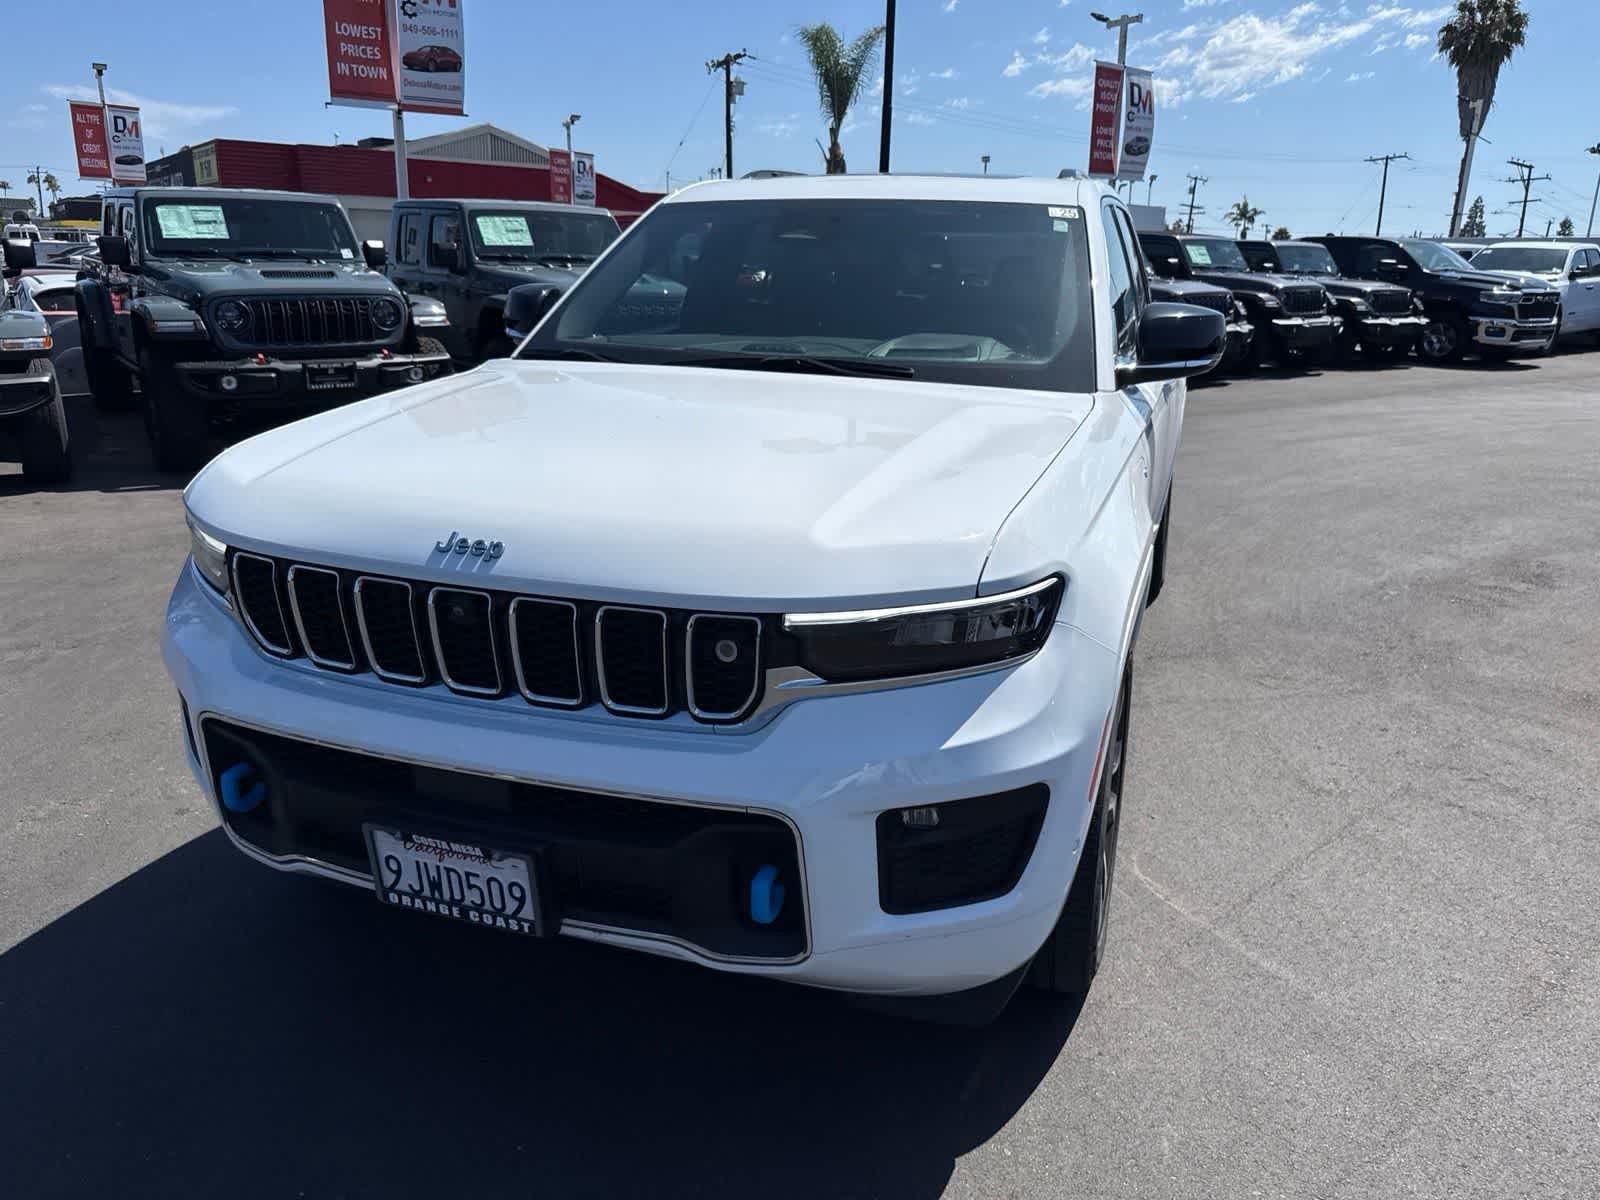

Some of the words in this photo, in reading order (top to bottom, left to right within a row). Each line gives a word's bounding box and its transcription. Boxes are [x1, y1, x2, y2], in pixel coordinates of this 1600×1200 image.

[335, 21, 382, 41] LOWEST
[340, 42, 382, 60] PRICES
[337, 62, 350, 77] IN
[350, 64, 388, 81] TOWN
[435, 531, 504, 562] Jeep
[412, 834, 449, 850] COSTA
[385, 855, 526, 918] 9JWD509
[389, 892, 461, 918] ORANGE
[469, 911, 531, 933] COAST
